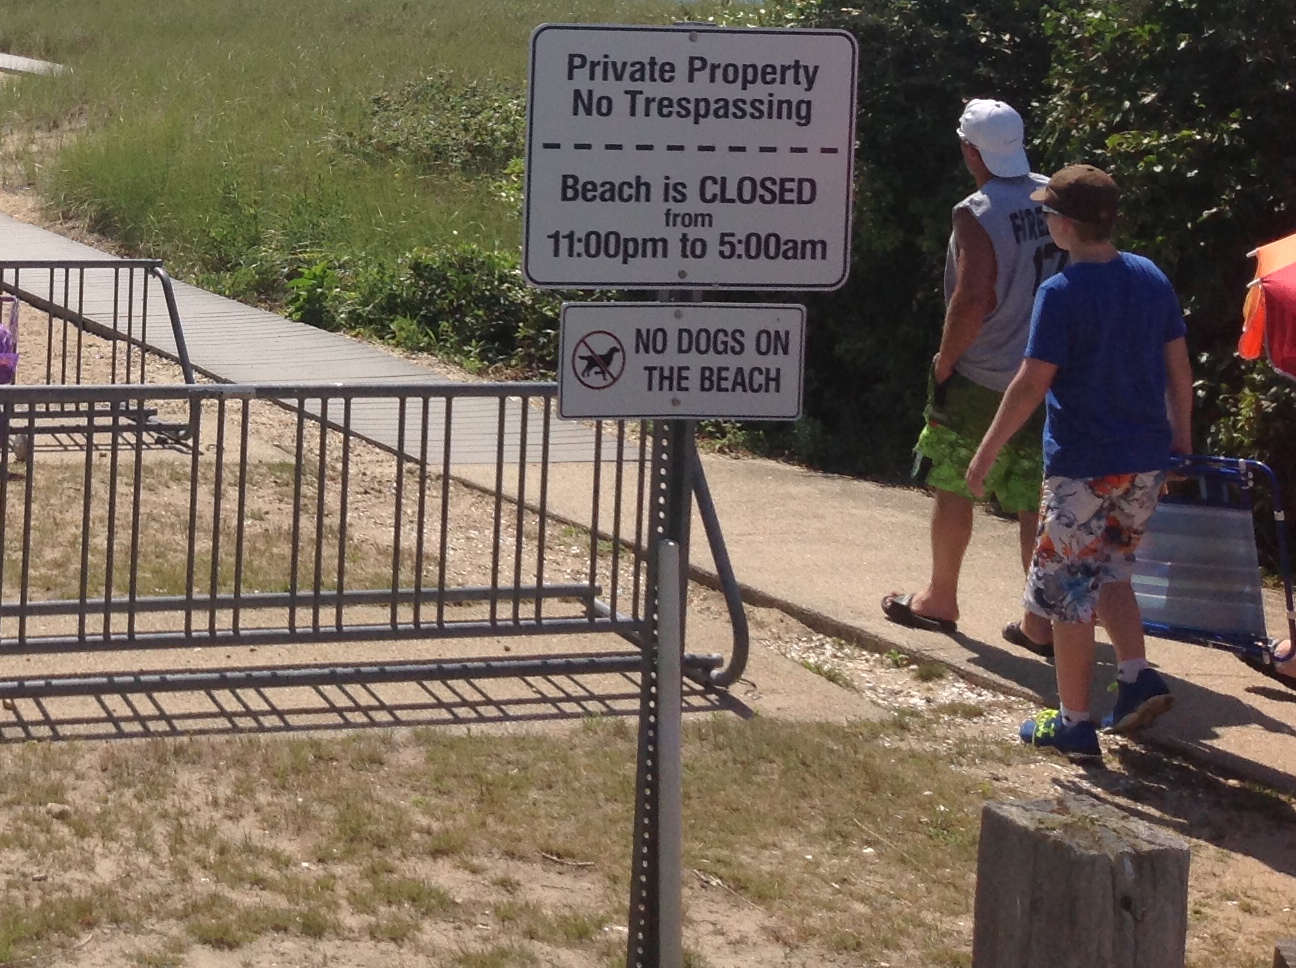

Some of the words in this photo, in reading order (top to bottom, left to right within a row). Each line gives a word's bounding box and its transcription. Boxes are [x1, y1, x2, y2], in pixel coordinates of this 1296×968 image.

[567, 53, 676, 84] Private
[687, 55, 820, 91] Property
[572, 88, 613, 117] No
[624, 89, 812, 127] Trespassing
[560, 173, 652, 203] Beach
[662, 175, 688, 204] is
[698, 175, 817, 205] CLOSED
[663, 207, 714, 228] from
[546, 230, 669, 265] 11:00pm
[679, 232, 708, 260] to
[718, 232, 828, 261] 5:00am
[634, 327, 668, 355] NO
[676, 328, 745, 356] DOGS
[754, 328, 790, 357] ON
[642, 365, 691, 392] THE
[699, 366, 781, 394] BEACH
